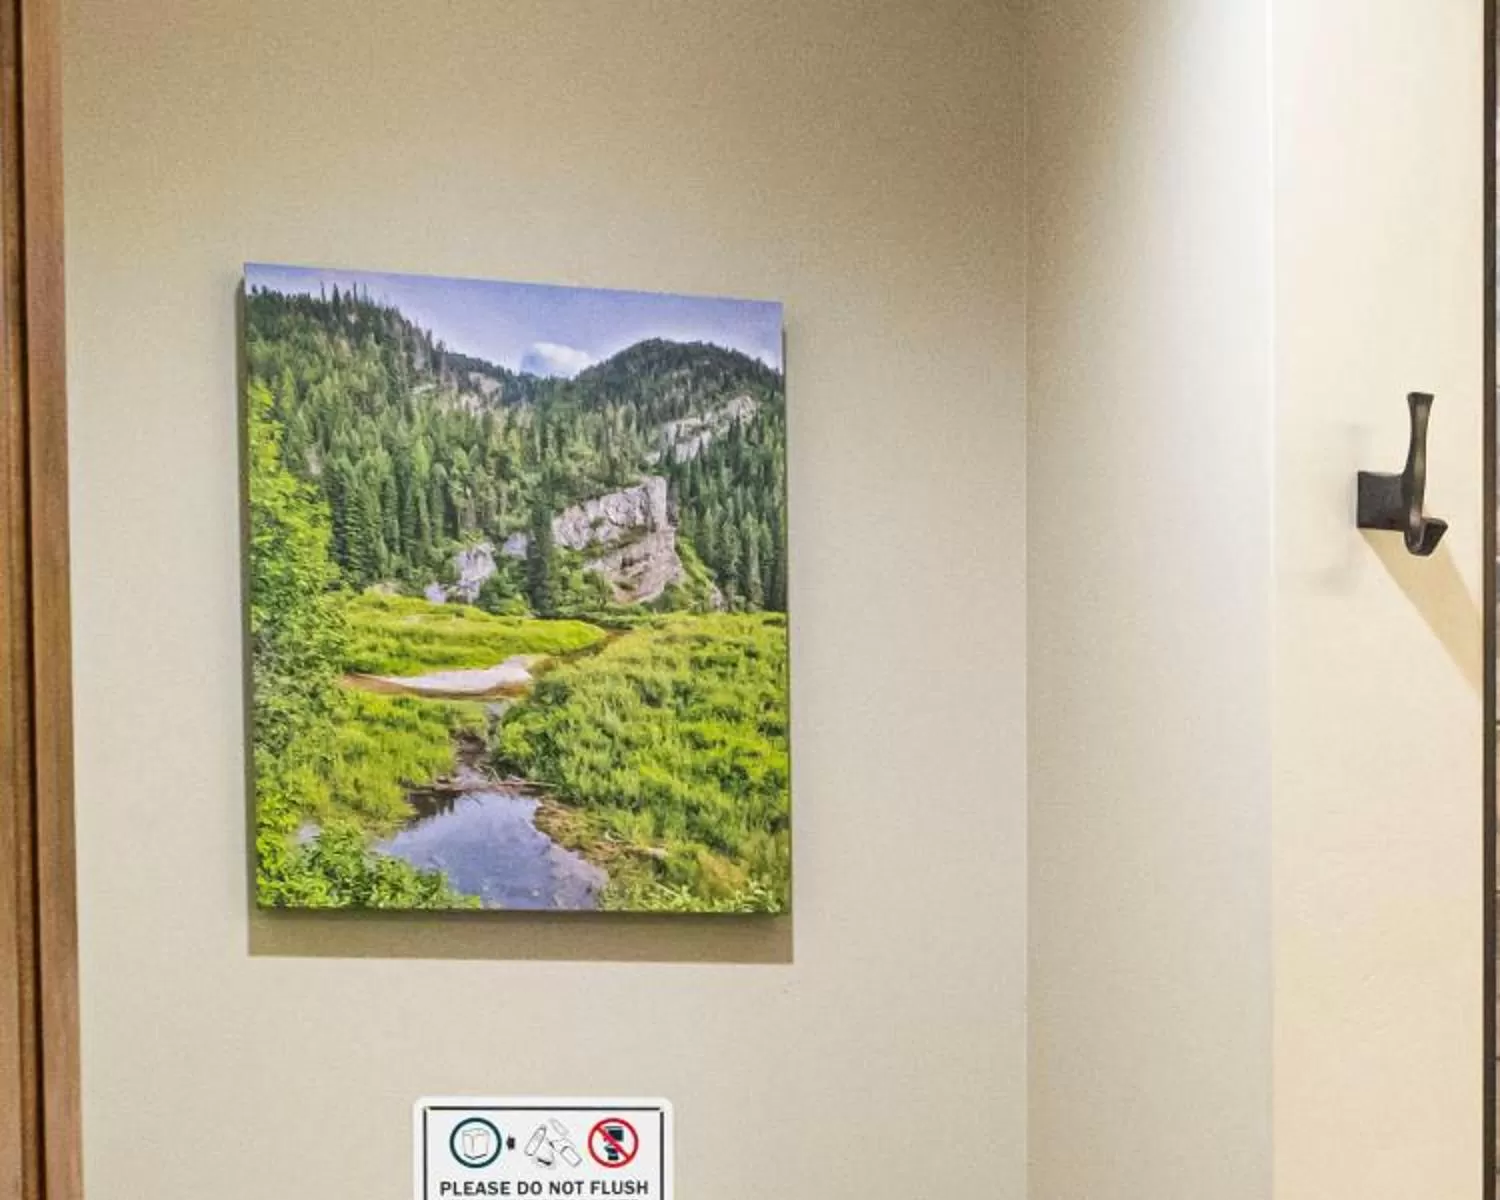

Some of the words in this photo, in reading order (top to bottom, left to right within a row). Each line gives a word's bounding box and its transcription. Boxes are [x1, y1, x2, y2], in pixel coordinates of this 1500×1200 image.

[439, 1180, 511, 1196] PLEASE
[517, 1180, 543, 1195] DO
[548, 1180, 585, 1195] NOT
[590, 1179, 649, 1195] FLUSH
